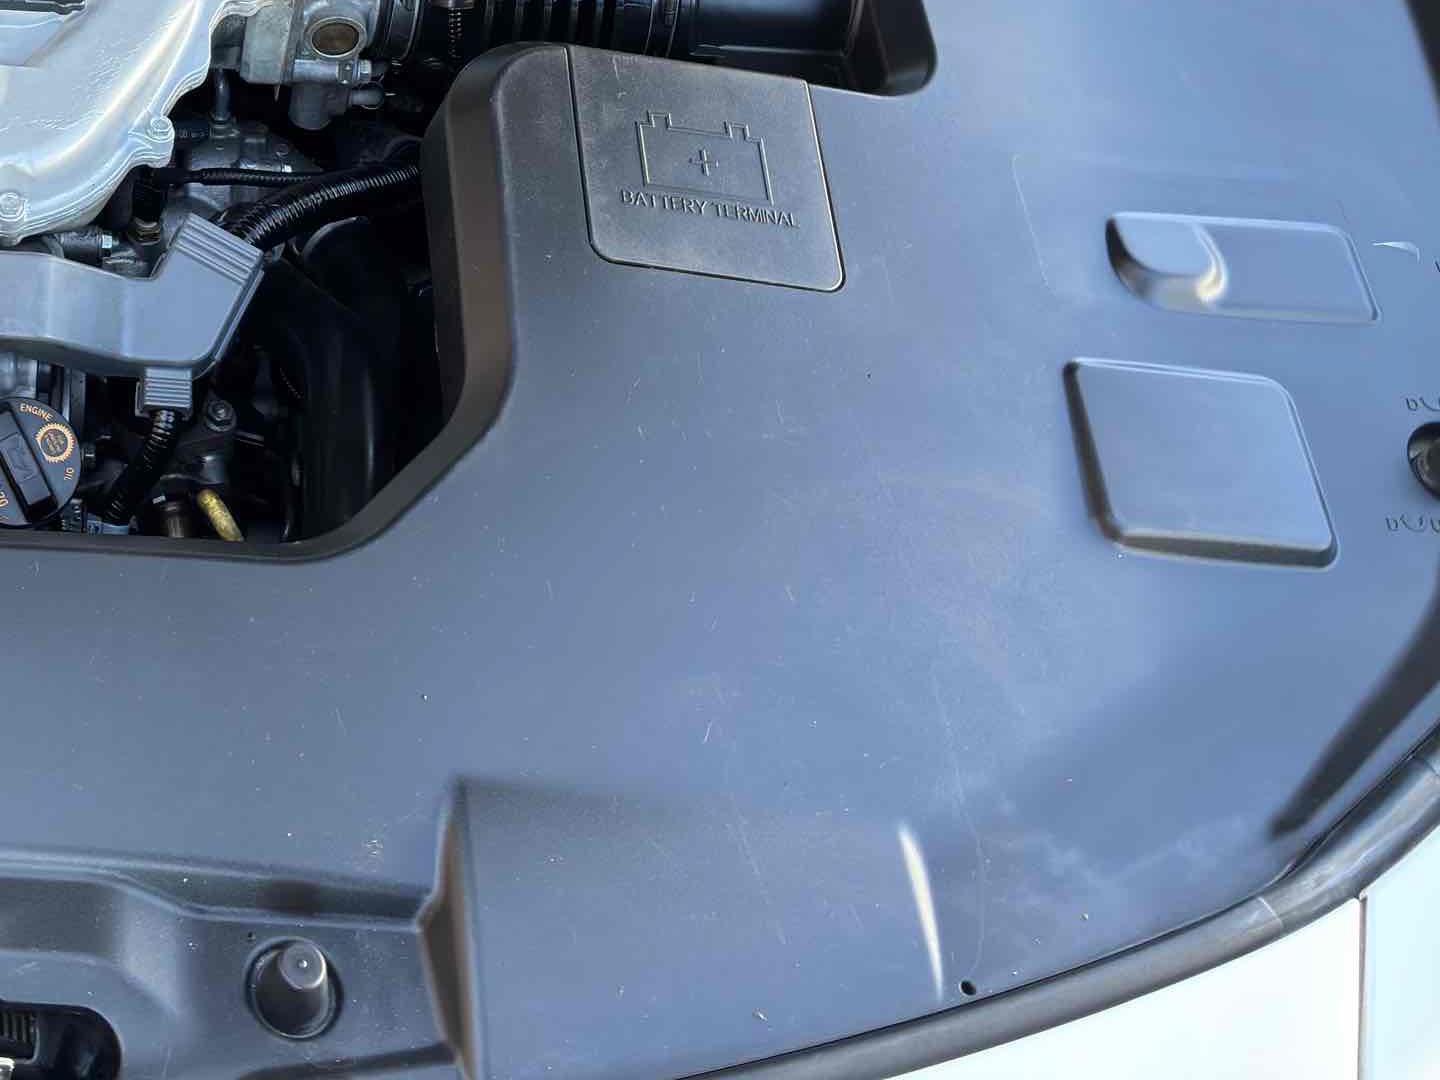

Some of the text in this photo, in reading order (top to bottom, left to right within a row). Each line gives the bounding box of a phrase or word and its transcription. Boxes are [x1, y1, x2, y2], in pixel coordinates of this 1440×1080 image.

[620, 188, 800, 229] BATTERY TERMINAL
[20, 402, 54, 422] ENGINE
